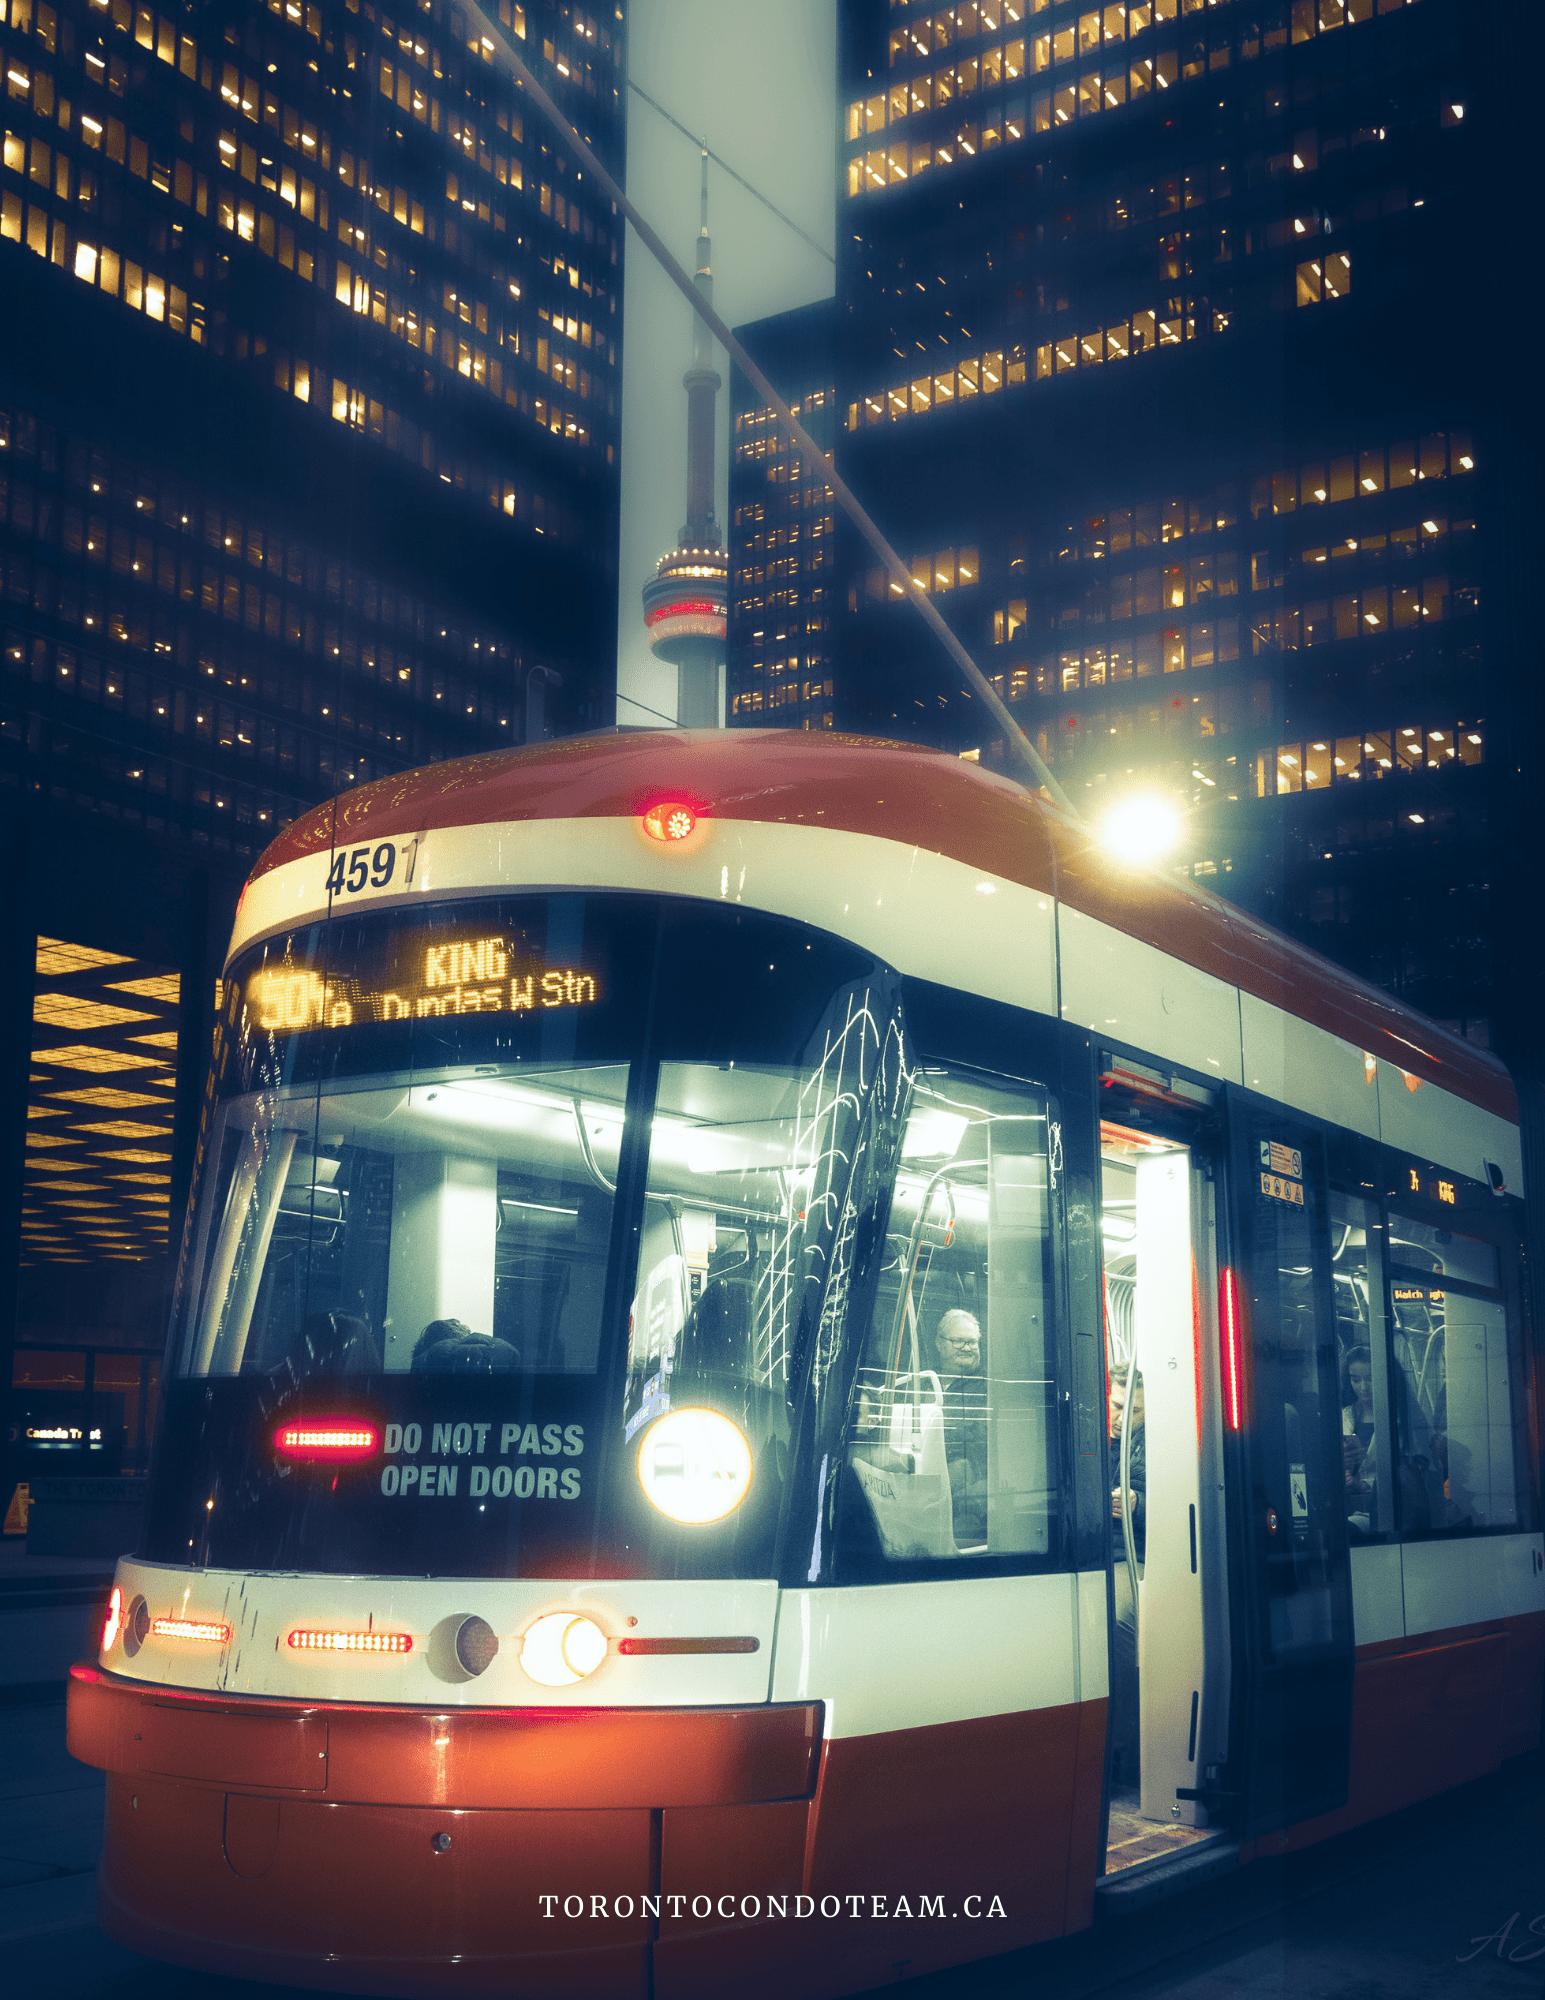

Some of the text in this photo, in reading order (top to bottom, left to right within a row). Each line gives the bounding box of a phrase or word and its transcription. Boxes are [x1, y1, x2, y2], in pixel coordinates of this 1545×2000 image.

[325, 838, 418, 896] 4591
[426, 937, 506, 988] KING
[511, 976, 533, 1011] W
[543, 970, 595, 1008] Stn
[26, 1427, 69, 1439] Canada
[69, 1428, 102, 1440] Trst
[383, 1422, 584, 1456] DO NOT PASS
[380, 1465, 582, 1500] OPEN DOORS
